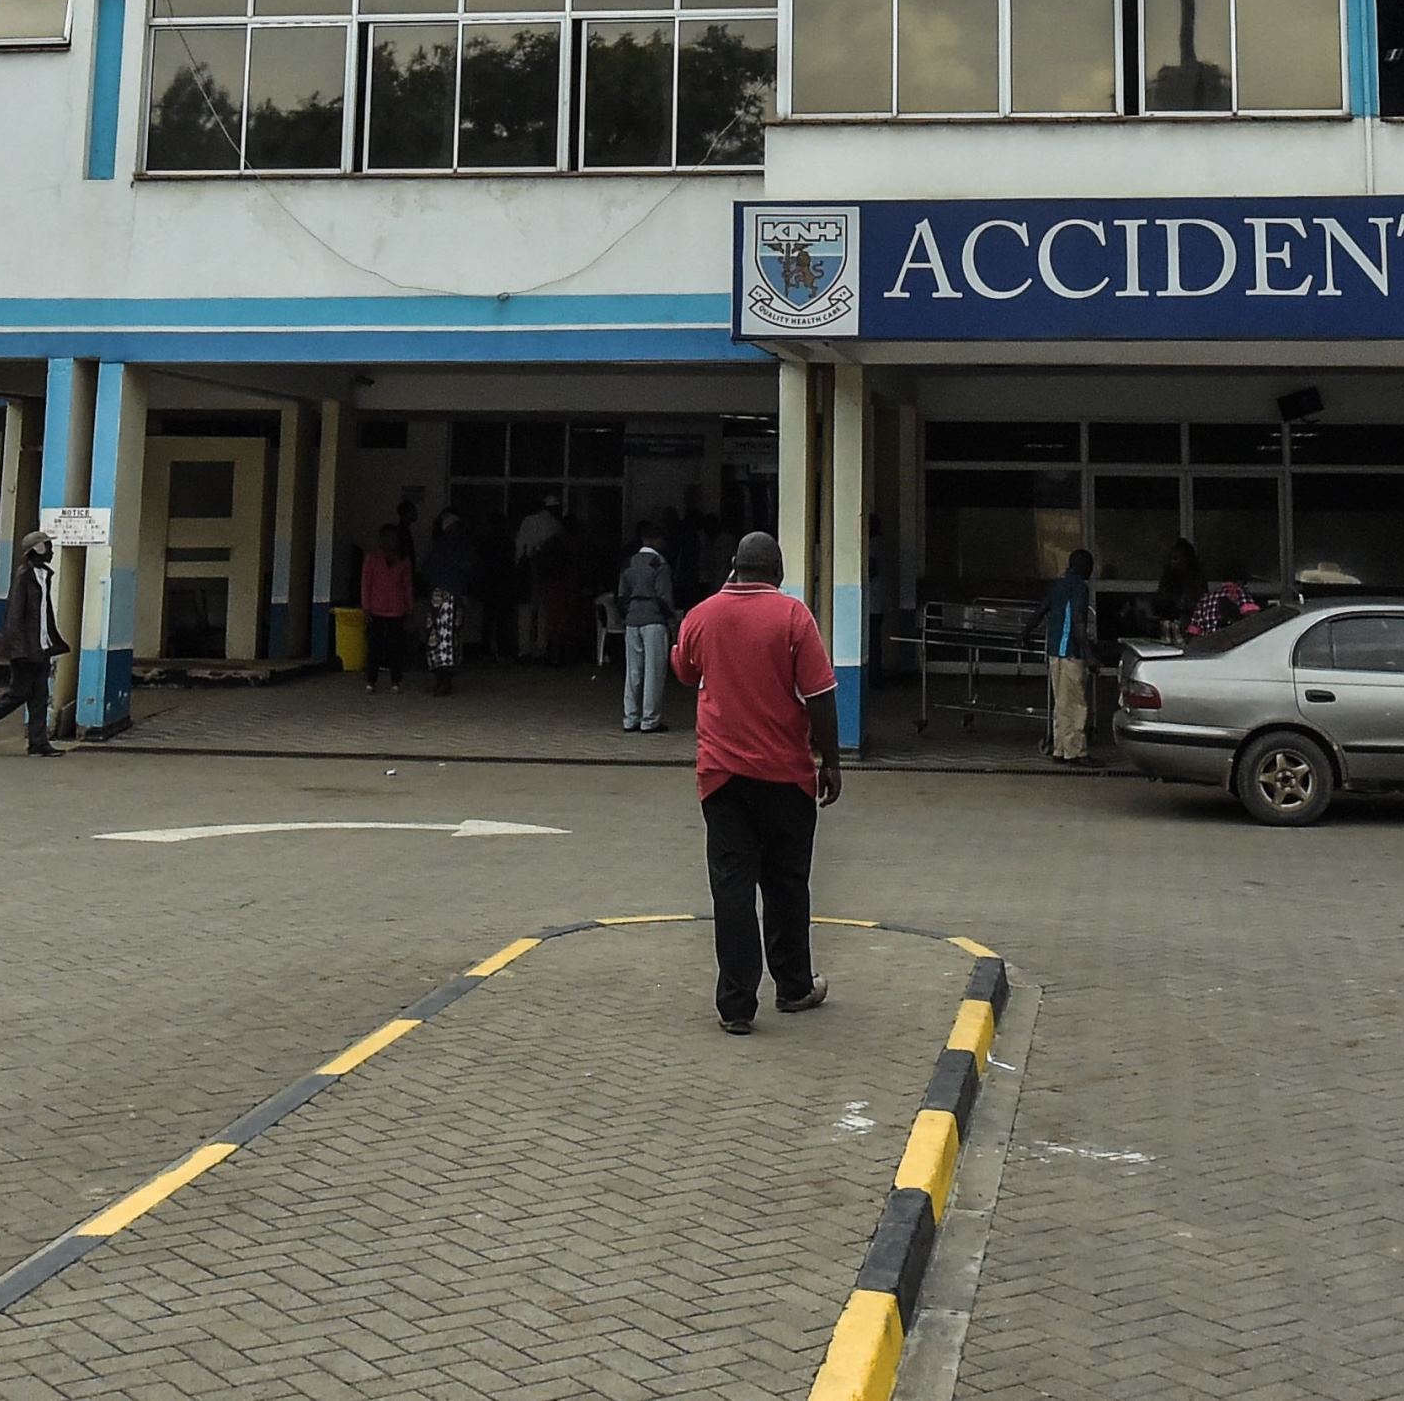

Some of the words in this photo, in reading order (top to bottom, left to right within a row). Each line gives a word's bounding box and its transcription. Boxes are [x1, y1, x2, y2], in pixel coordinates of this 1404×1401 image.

[759, 305, 789, 322] QUALITY
[791, 315, 822, 324] HEALTH
[823, 307, 843, 320] CARE
